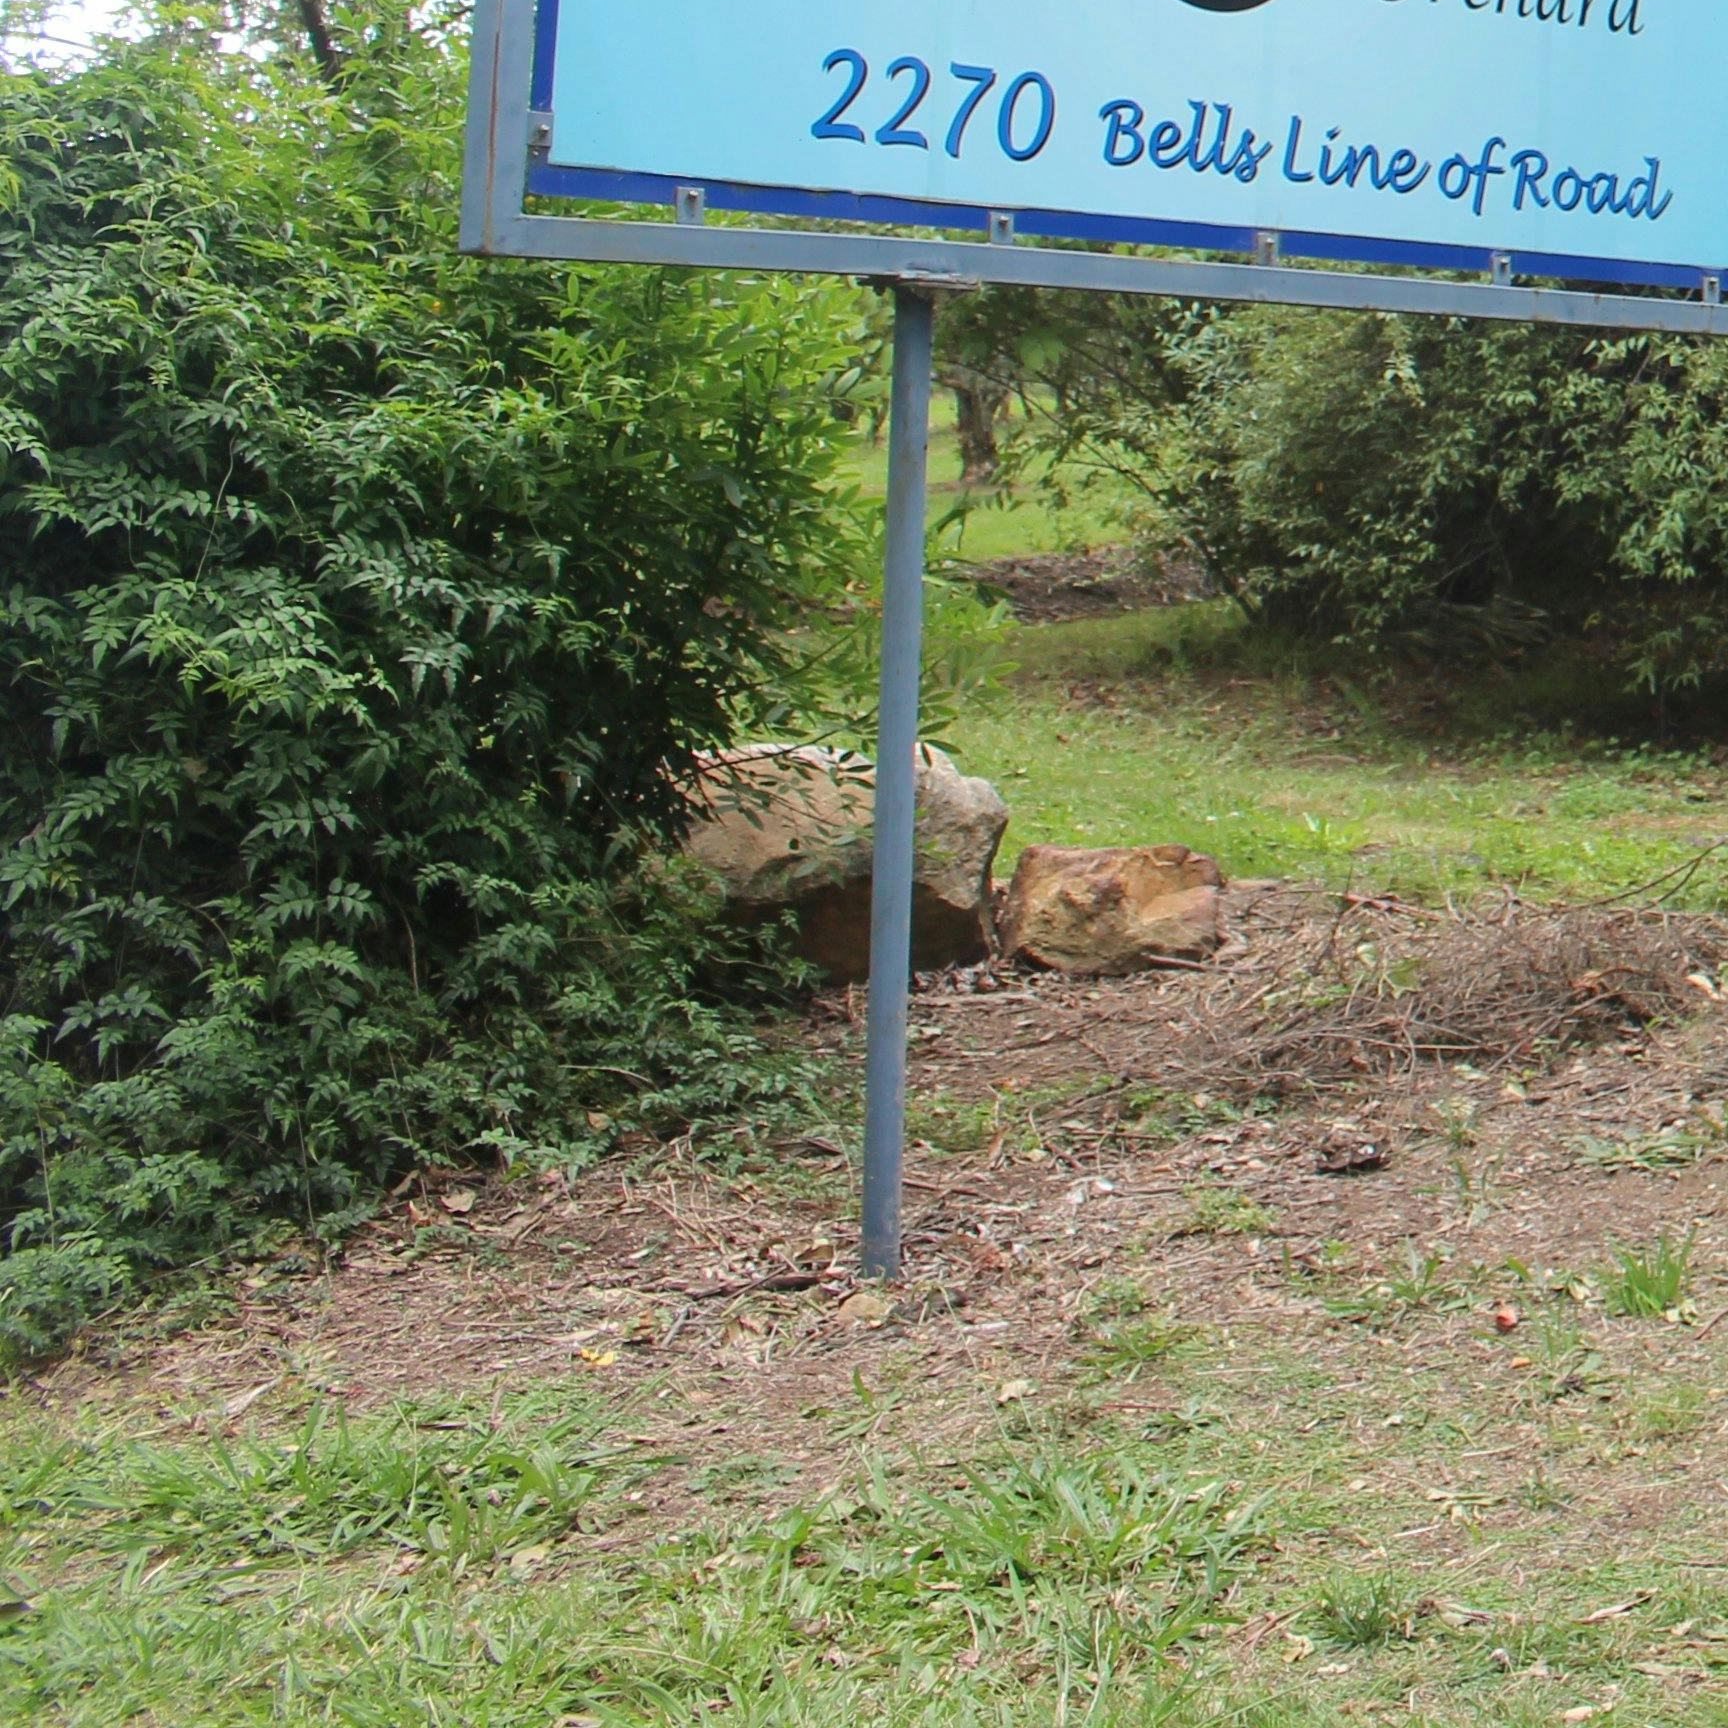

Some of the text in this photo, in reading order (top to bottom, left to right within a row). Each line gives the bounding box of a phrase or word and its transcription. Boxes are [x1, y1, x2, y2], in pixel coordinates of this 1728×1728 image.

[810, 47, 1673, 220] 2270 Bells Line of Road
